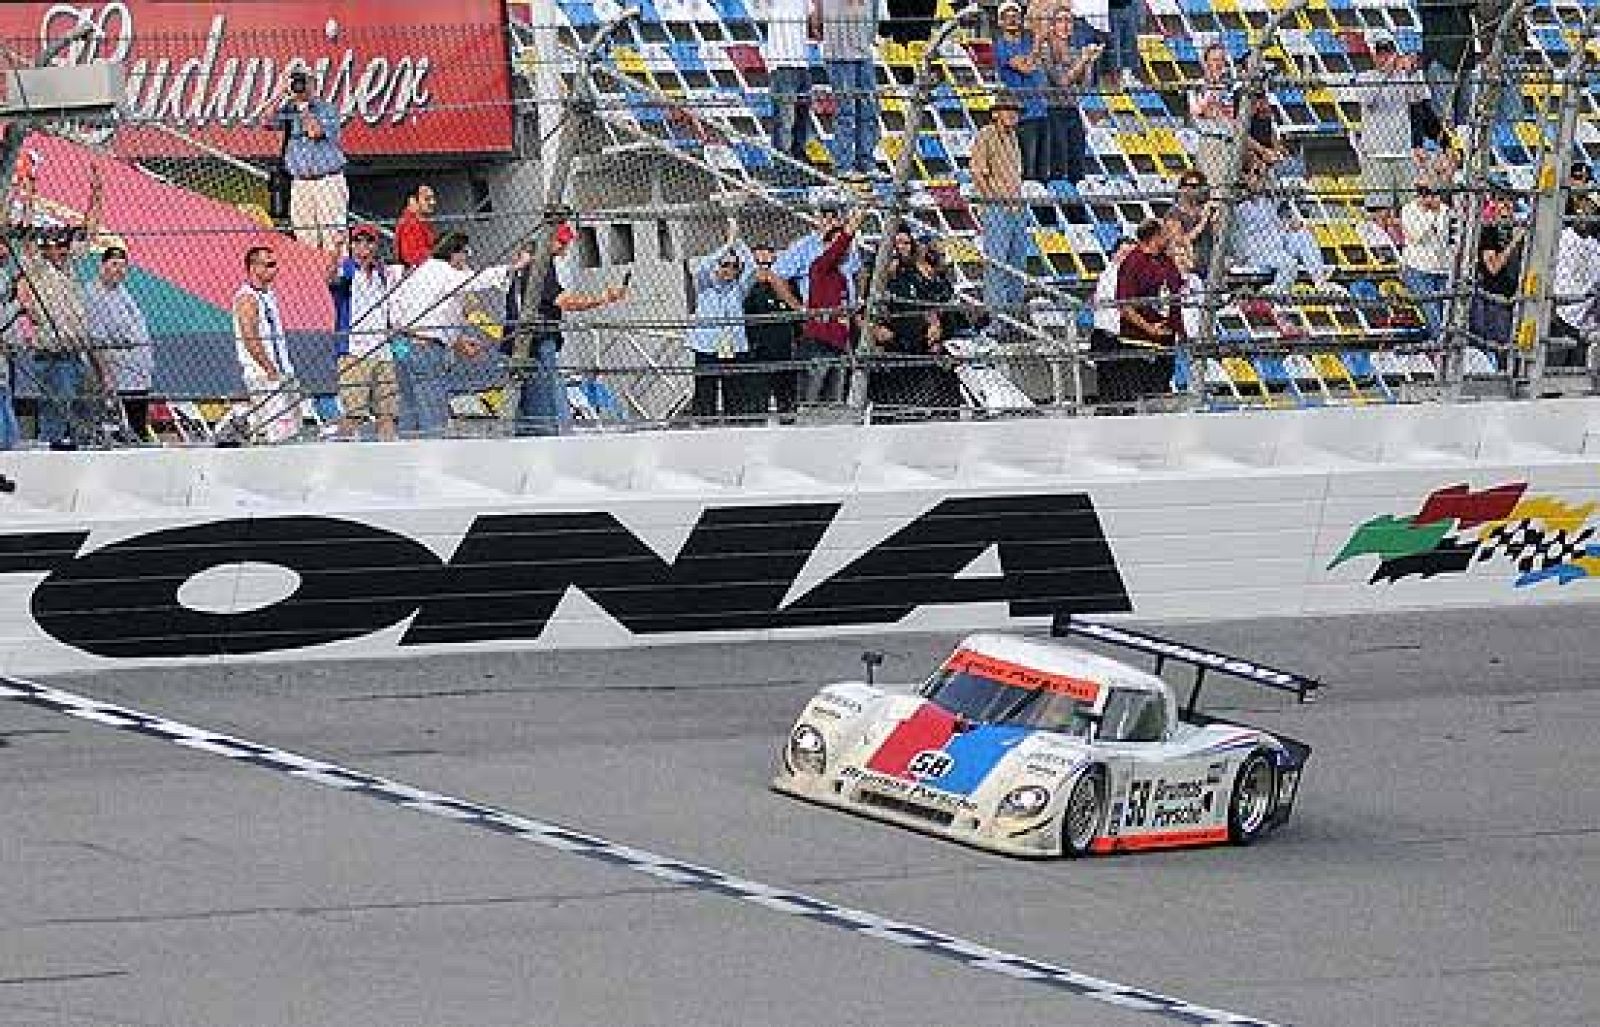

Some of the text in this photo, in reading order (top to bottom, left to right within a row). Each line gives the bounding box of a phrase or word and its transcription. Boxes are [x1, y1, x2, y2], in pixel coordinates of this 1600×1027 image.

[910, 751, 951, 778] 58
[840, 765, 978, 811] Brumos Porsche
[1154, 779, 1202, 800] Brumos
[1125, 778, 1150, 826] 58
[1152, 802, 1202, 826] Porsche
